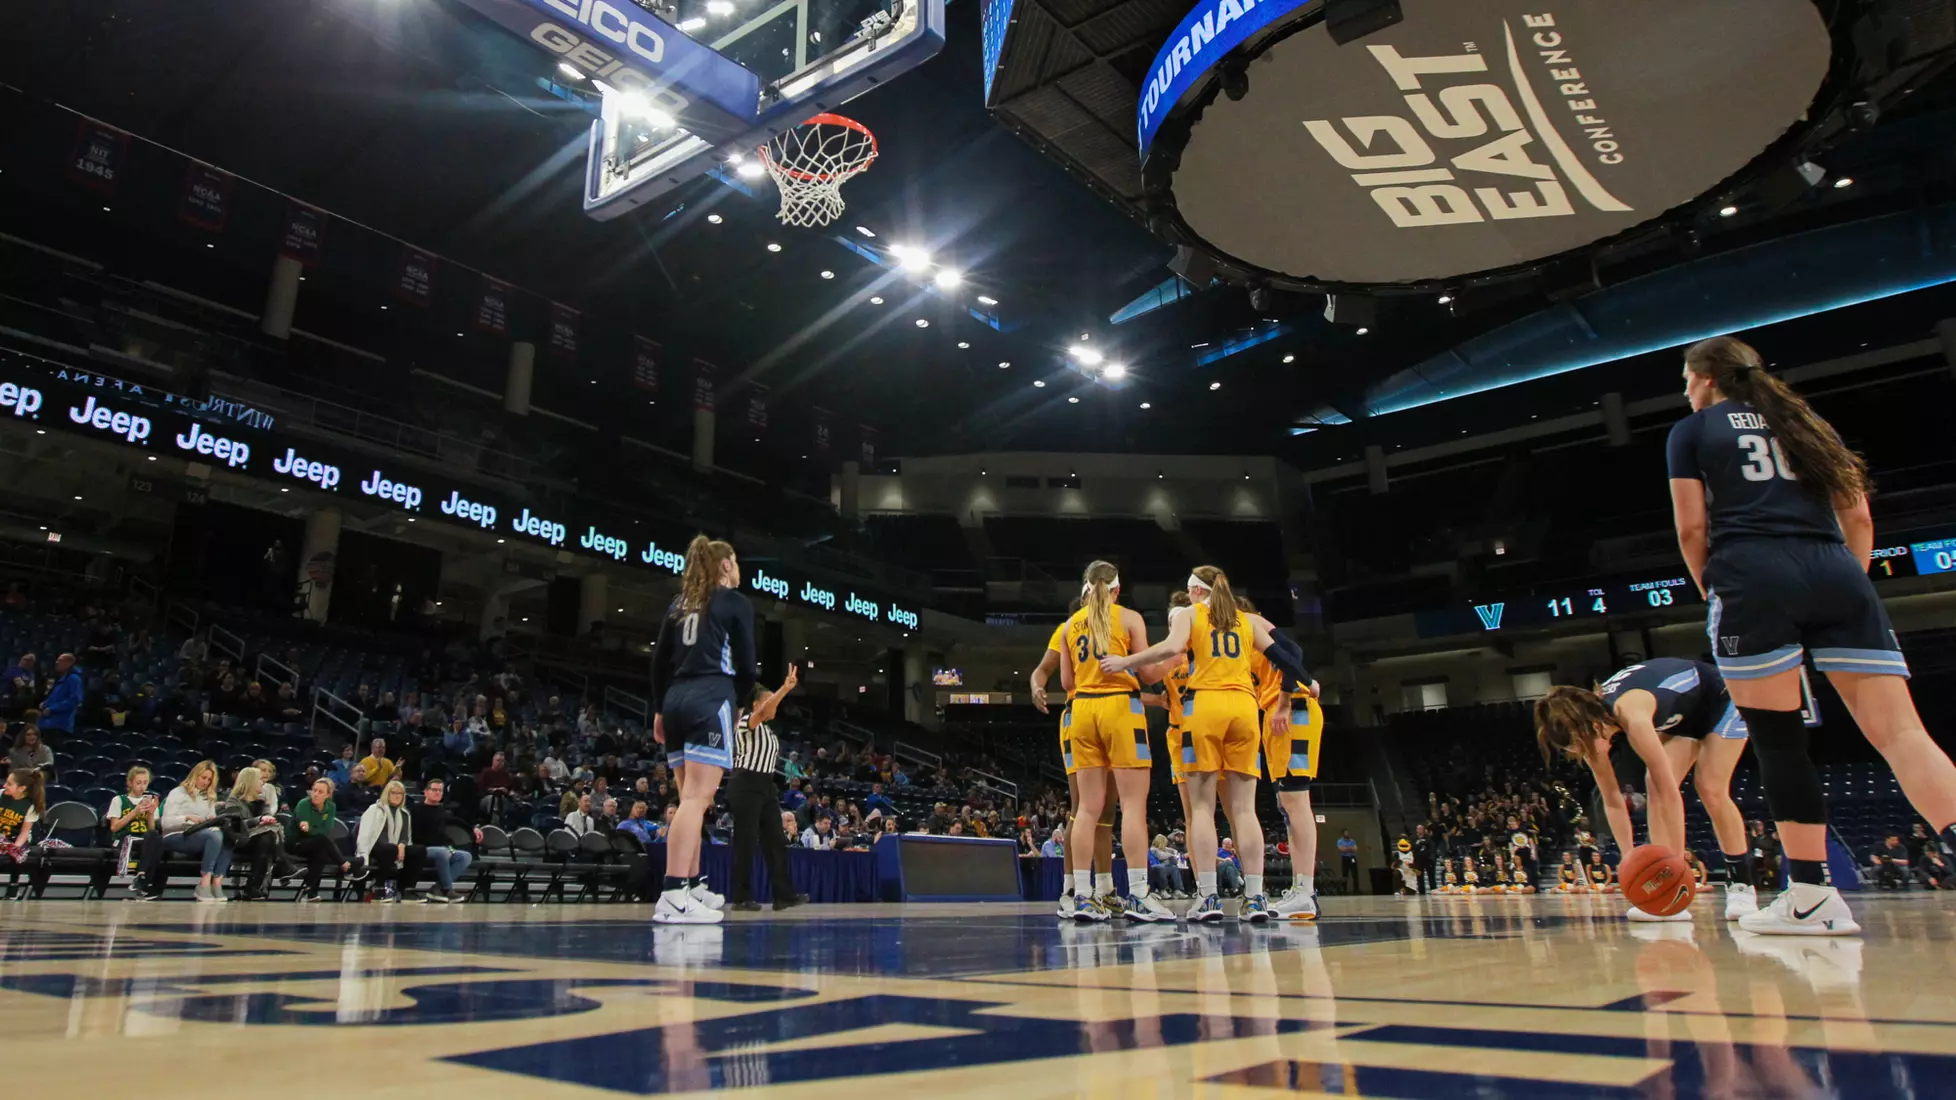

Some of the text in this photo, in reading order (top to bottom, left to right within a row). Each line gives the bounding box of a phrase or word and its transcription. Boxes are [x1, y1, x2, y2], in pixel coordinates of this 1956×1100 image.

[1140, 0, 1265, 130] TOURNA
[1522, 12, 1624, 165] CONFERENCE
[1366, 44, 1575, 220] EAST
[90, 144, 111, 159] NIT
[75, 158, 114, 180] 1945
[1302, 115, 1485, 228] BIG
[70, 396, 152, 445] Jeep
[176, 423, 250, 469] Jeep
[1738, 434, 1798, 482] 30
[274, 448, 341, 491] Jeep
[361, 470, 423, 521] Jeep
[441, 491, 497, 529] Jeep
[513, 508, 566, 547] Jeep
[581, 526, 628, 562] Jeep
[641, 541, 684, 575] Jeep
[1868, 545, 1909, 560] ERIOD
[1879, 559, 1894, 576] 1
[752, 569, 789, 600] Jeep
[801, 582, 836, 611] Jeep
[1629, 580, 1656, 593] TEAM
[1648, 589, 1674, 607] 03
[845, 593, 879, 621] Jeep
[888, 604, 919, 630] Jeep
[1547, 597, 1574, 617] 11
[1592, 597, 1607, 615] 4
[681, 612, 700, 647] 0
[1210, 629, 1241, 658] 10
